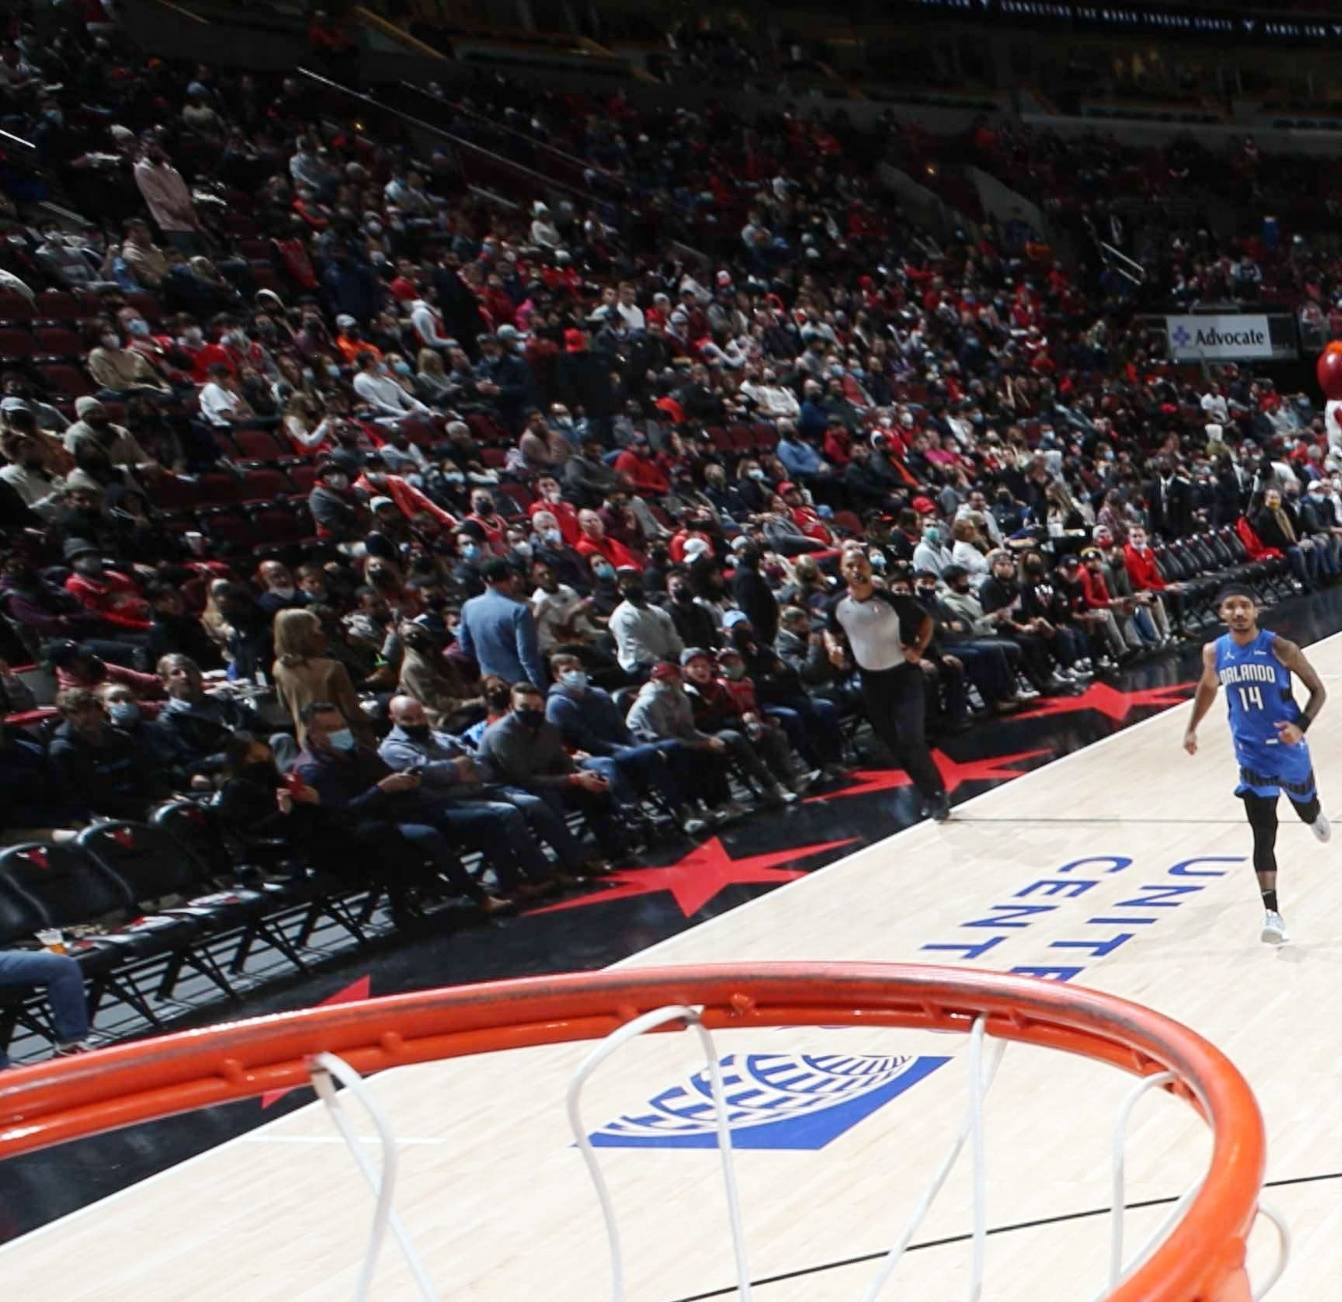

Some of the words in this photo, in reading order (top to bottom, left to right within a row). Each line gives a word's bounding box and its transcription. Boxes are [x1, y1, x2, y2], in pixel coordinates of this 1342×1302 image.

[1196, 326, 1264, 346] Advocate
[1219, 664, 1276, 685] ORLANDO
[1239, 687, 1264, 712] 14
